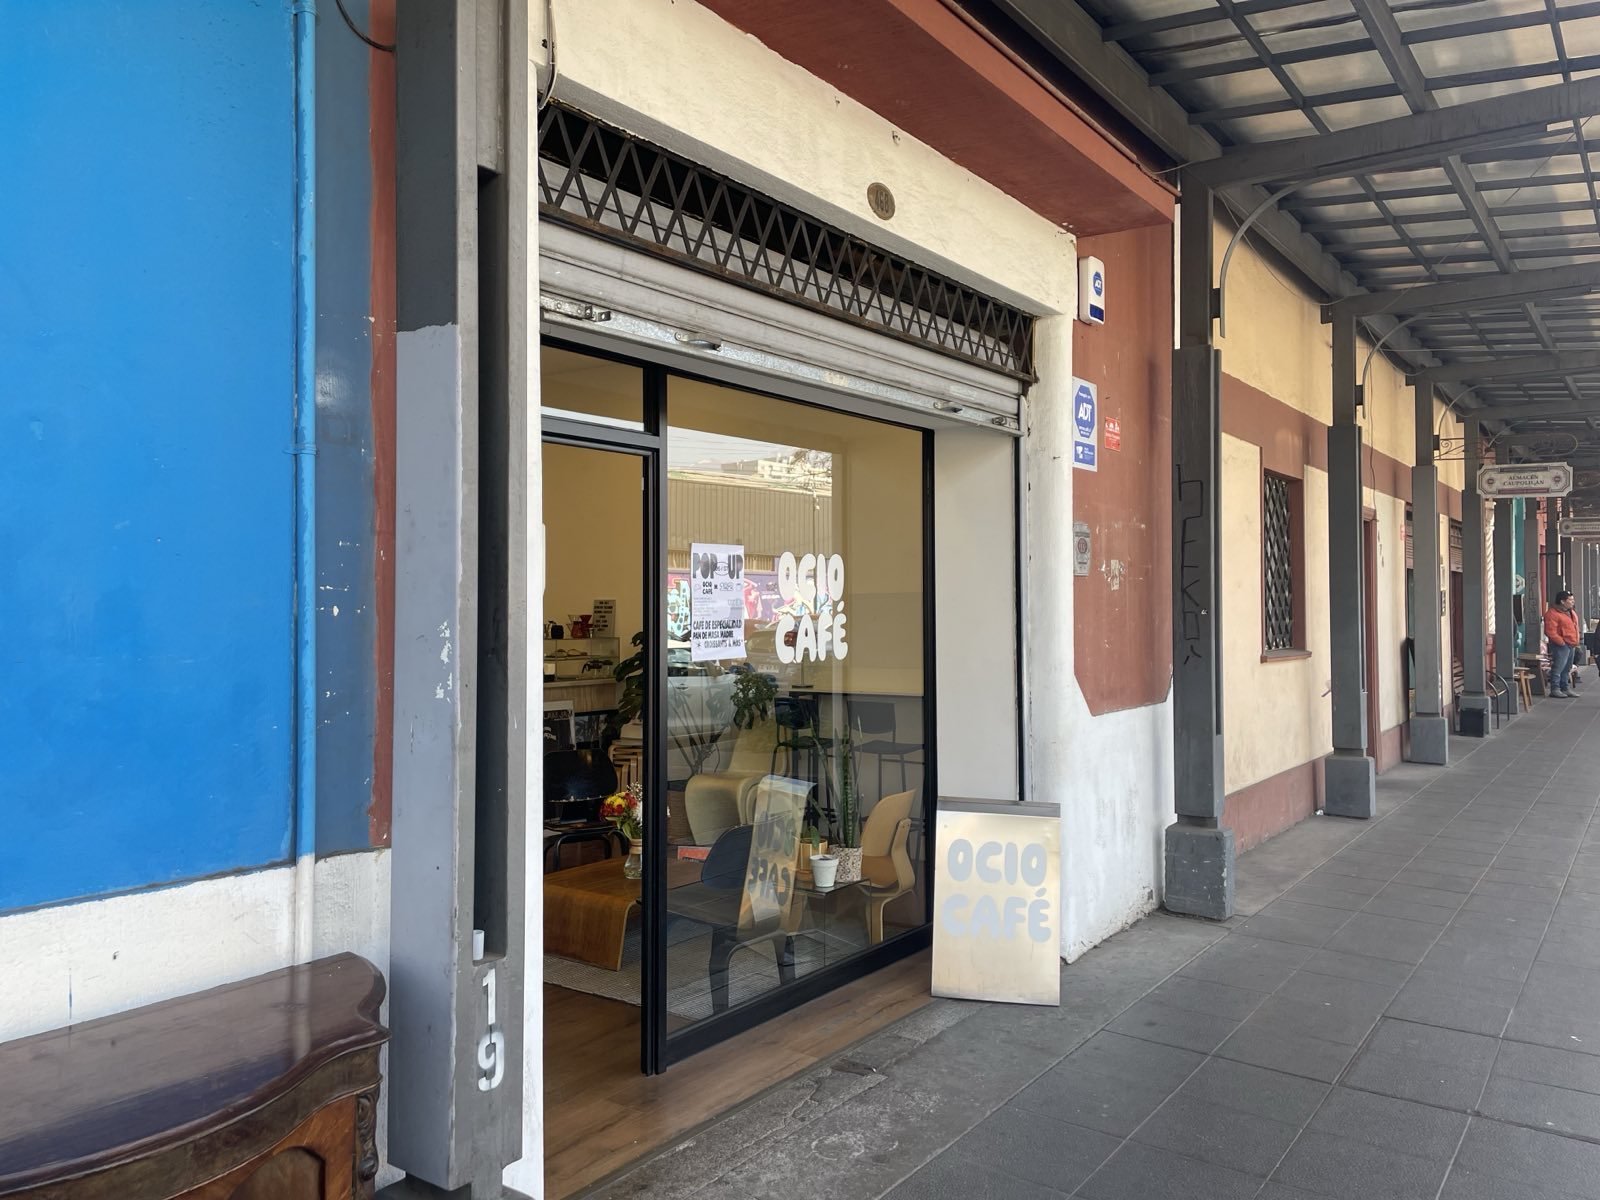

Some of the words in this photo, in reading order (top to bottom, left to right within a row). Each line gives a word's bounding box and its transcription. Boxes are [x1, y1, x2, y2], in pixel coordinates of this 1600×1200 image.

[1078, 402, 1093, 422] ADT
[693, 553, 718, 579] POP
[727, 554, 743, 579] UP
[778, 552, 845, 602] OCIO
[775, 600, 849, 664] CAFÉ
[947, 838, 1048, 887] OCIO
[942, 887, 1052, 943] CAFÉ
